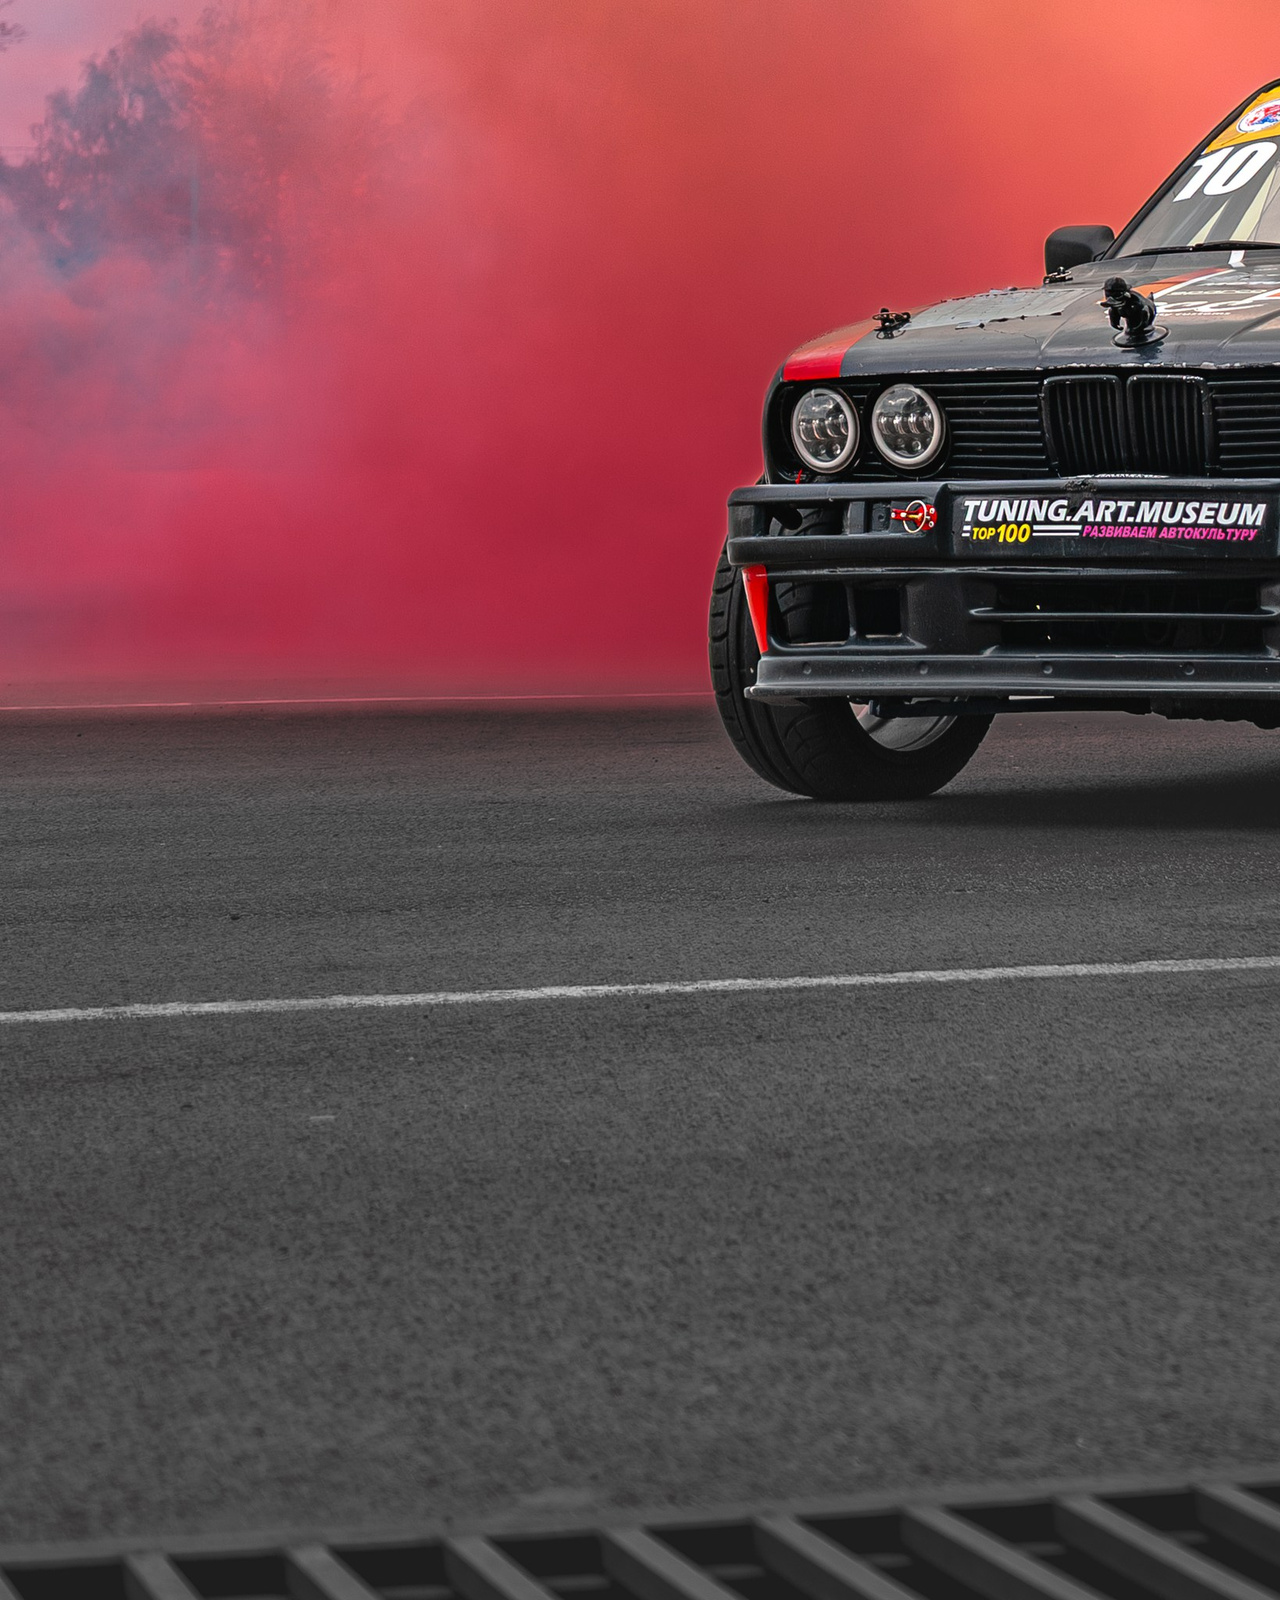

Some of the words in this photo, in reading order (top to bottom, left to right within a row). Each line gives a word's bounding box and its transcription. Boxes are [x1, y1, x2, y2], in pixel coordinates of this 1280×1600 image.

[1172, 141, 1278, 203] 10
[963, 499, 1267, 526] TUNING.ART.MUSEUM
[1082, 524, 1158, 539] РАЗВИВАЕМ
[1159, 526, 1258, 541] АВТОКУЛЬТУРУ
